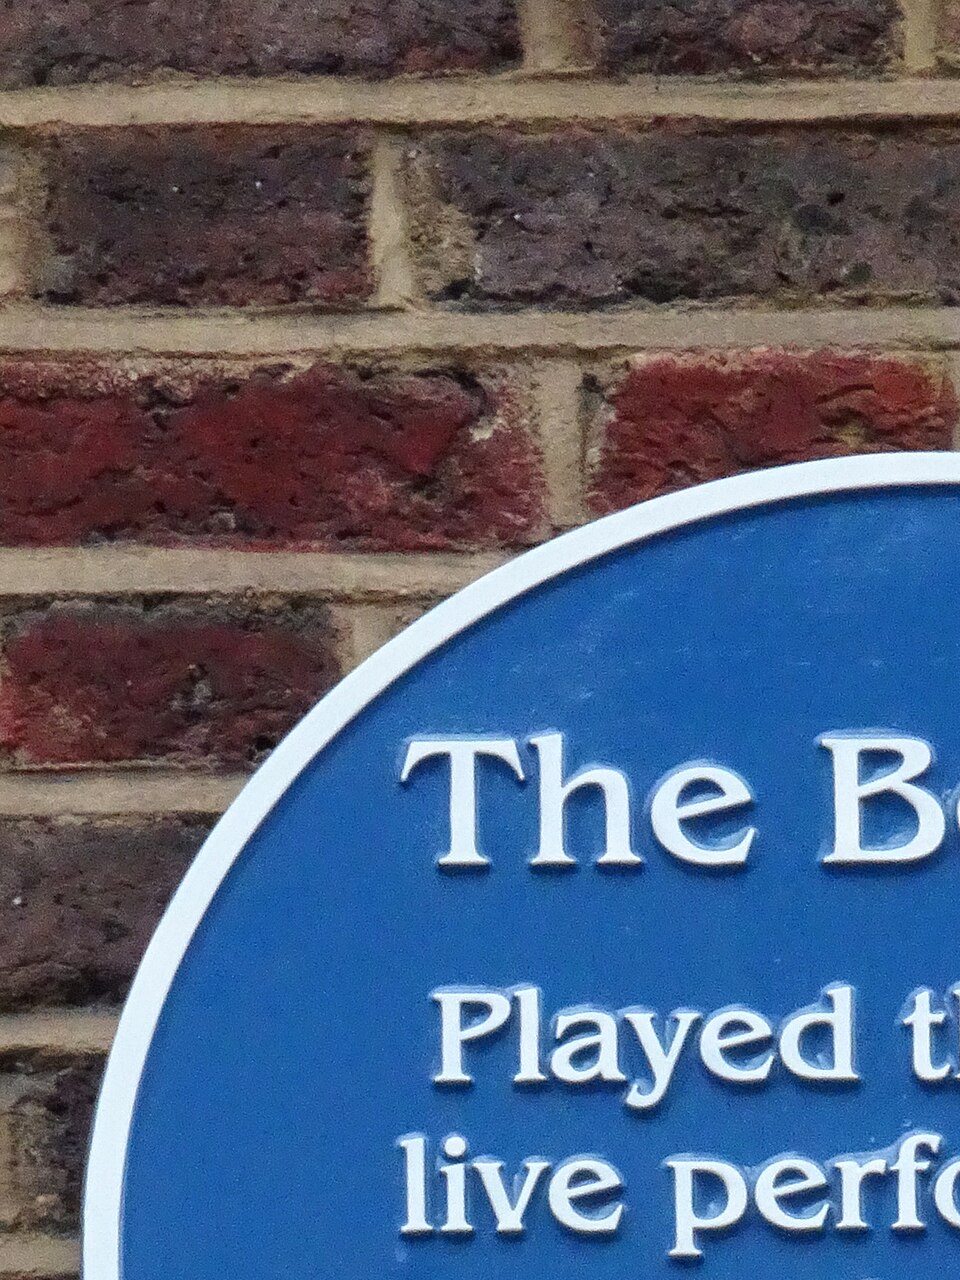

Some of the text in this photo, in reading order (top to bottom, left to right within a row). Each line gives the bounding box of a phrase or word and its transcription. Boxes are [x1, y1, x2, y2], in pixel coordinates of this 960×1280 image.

[398, 729, 758, 867] The
[430, 983, 861, 1110] Played
[397, 1132, 625, 1235] live
